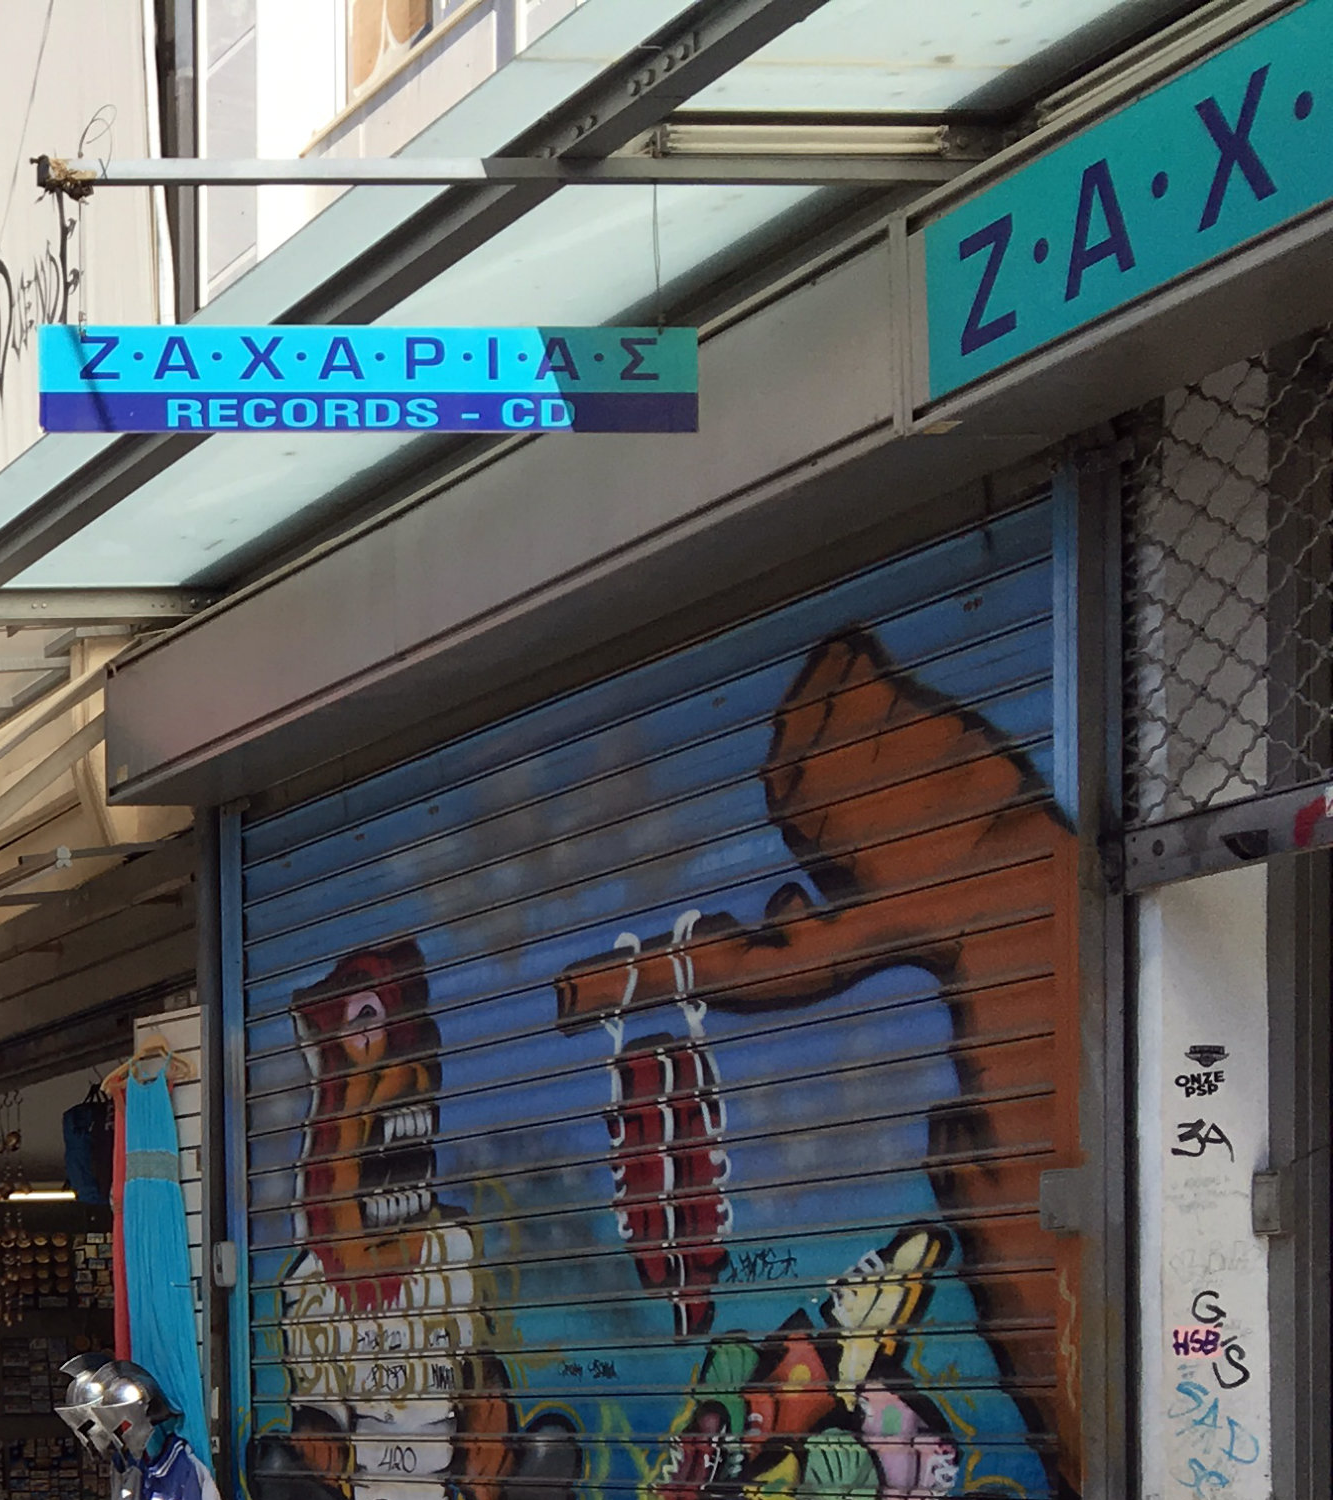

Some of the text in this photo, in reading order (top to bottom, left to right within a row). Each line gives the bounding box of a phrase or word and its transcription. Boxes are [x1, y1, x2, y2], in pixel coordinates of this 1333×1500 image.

[166, 399, 439, 429] RECORDS
[500, 399, 577, 429] CD
[1174, 1070, 1226, 1088] ONZE
[1185, 1081, 1219, 1098] PSP
